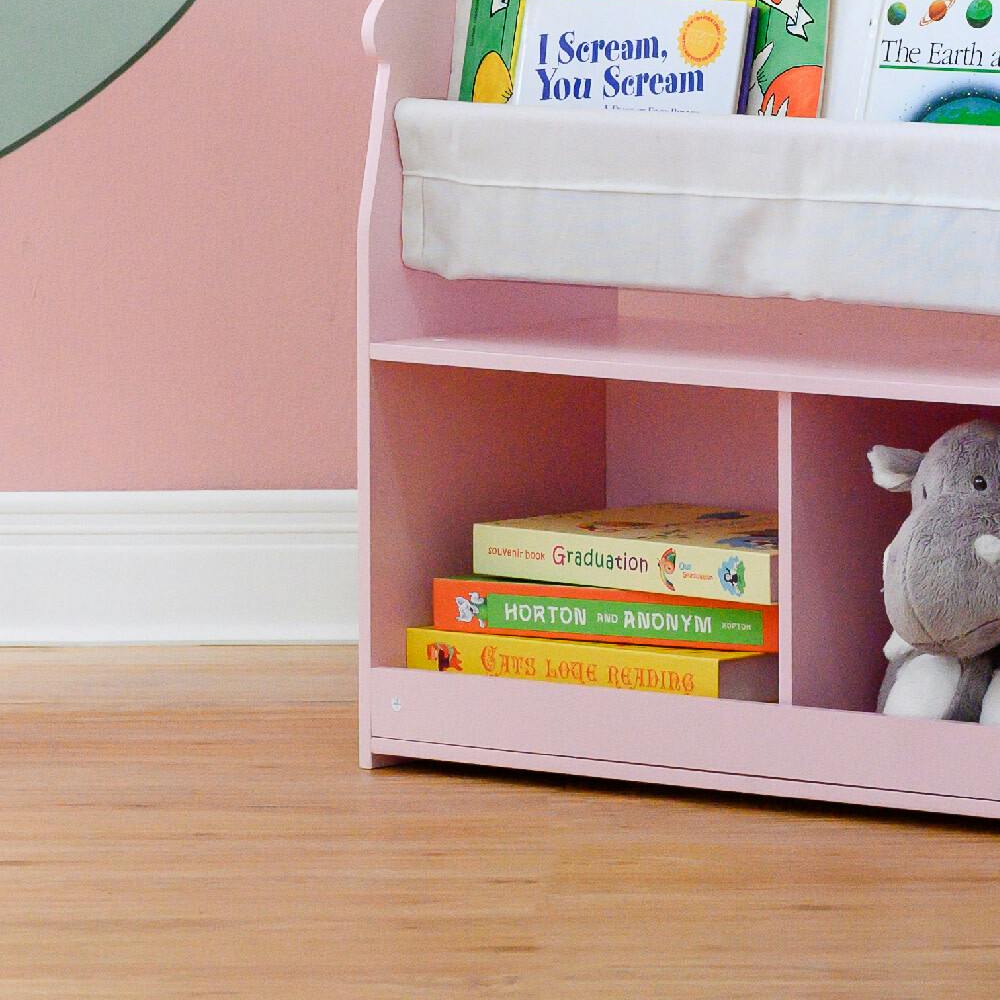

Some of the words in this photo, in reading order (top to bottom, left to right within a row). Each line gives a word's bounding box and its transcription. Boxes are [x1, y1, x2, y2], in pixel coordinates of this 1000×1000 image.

[538, 32, 549, 65] I
[557, 31, 668, 66] Scream,
[881, 39, 921, 65] The
[929, 41, 984, 68] Earth
[535, 66, 592, 101] You
[602, 69, 705, 99] Scream
[552, 545, 649, 573] Graduation
[504, 602, 587, 626] HORTON
[597, 612, 618, 624] AND
[623, 610, 713, 634] ANONYM
